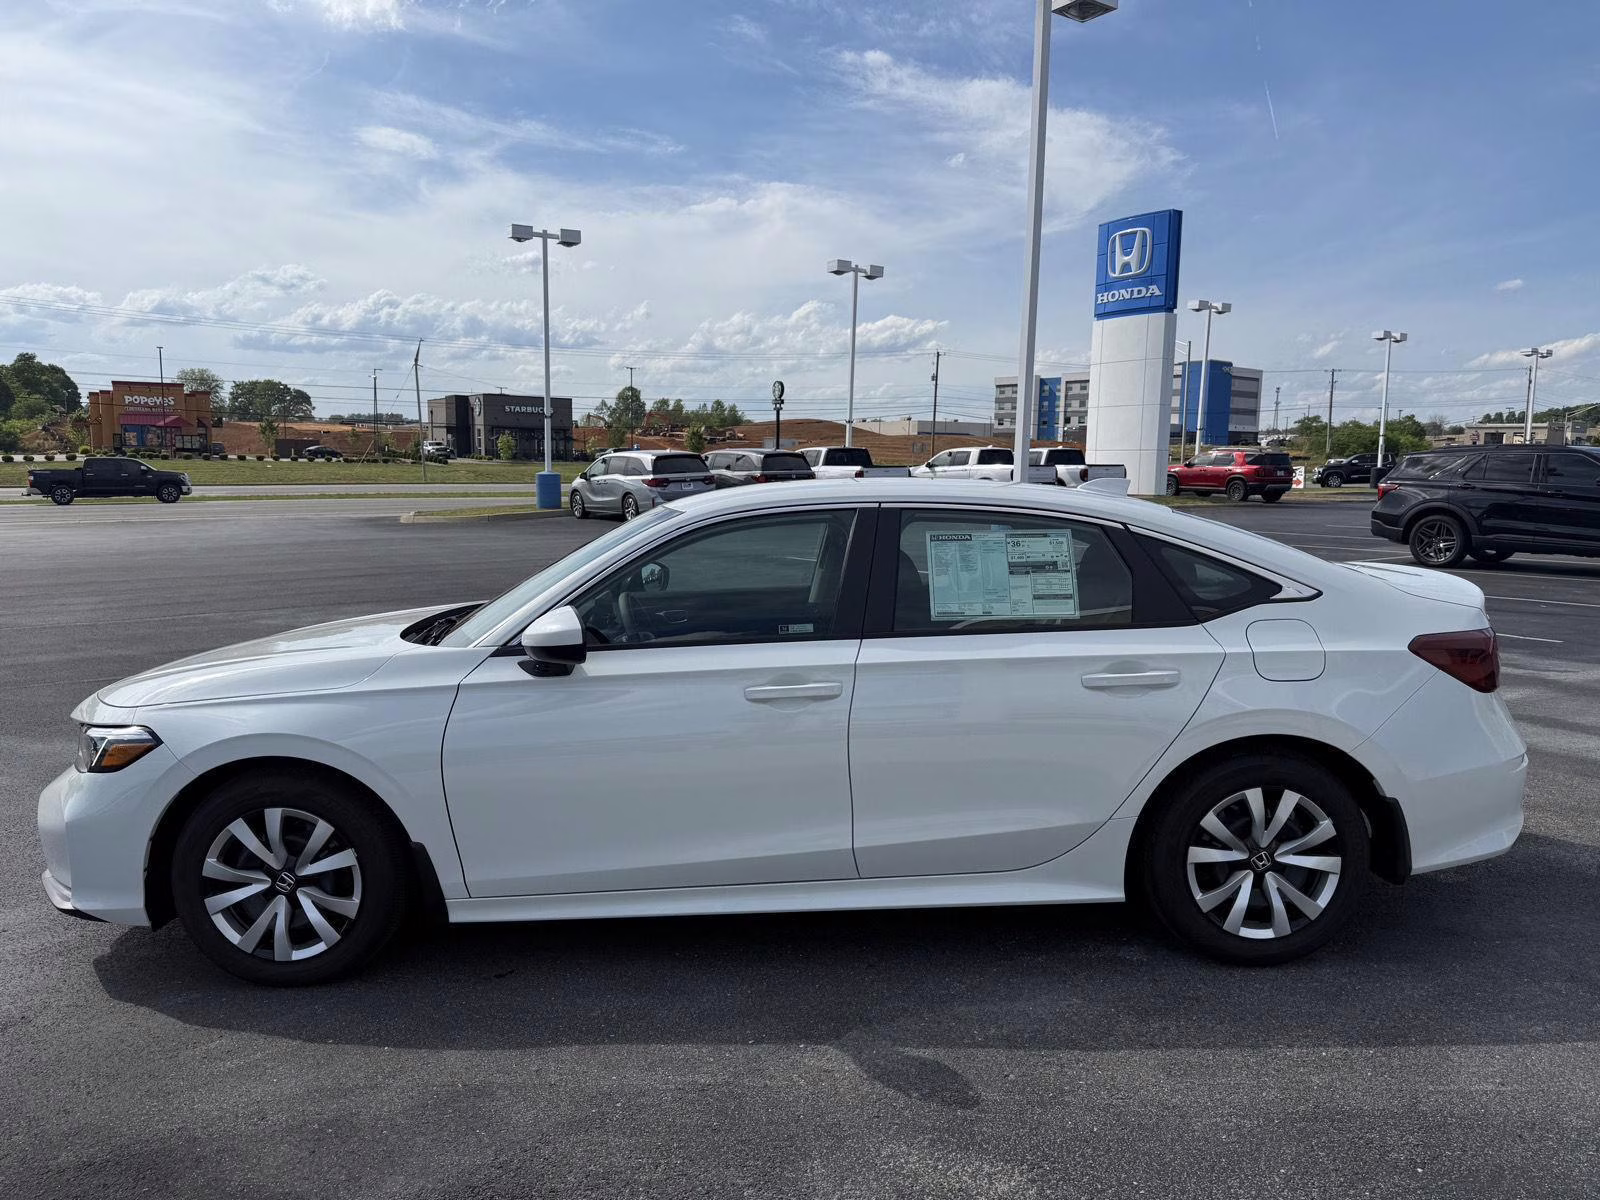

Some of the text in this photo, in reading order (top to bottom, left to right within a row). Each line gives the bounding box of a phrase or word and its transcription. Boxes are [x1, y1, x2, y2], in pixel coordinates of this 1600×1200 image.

[1097, 285, 1162, 304] HONDA
[505, 405, 554, 414] STARBUCS
[1010, 540, 1021, 548] 36
